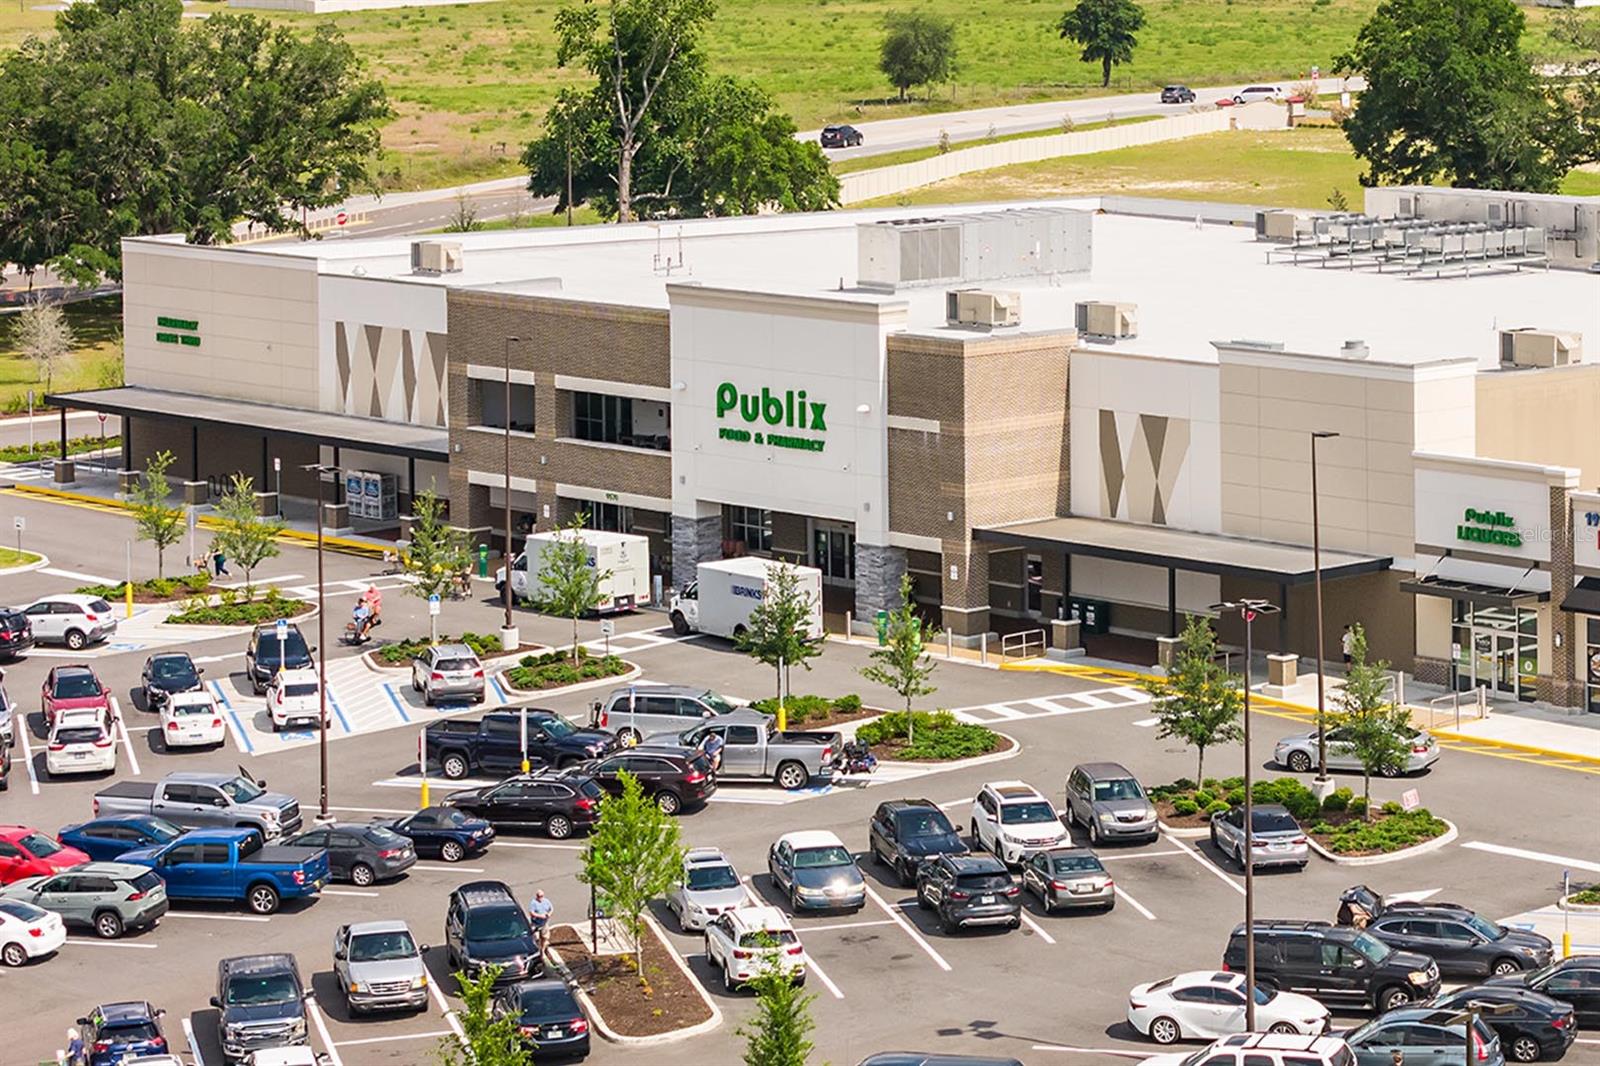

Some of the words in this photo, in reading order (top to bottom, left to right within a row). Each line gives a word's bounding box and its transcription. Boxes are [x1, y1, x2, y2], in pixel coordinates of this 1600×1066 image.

[716, 382, 827, 431] Publix
[719, 427, 751, 442] FOOD
[754, 432, 764, 445] &
[767, 434, 825, 452] PHARMACY
[1464, 508, 1515, 528] Publix
[1457, 525, 1523, 548] LIQUORS
